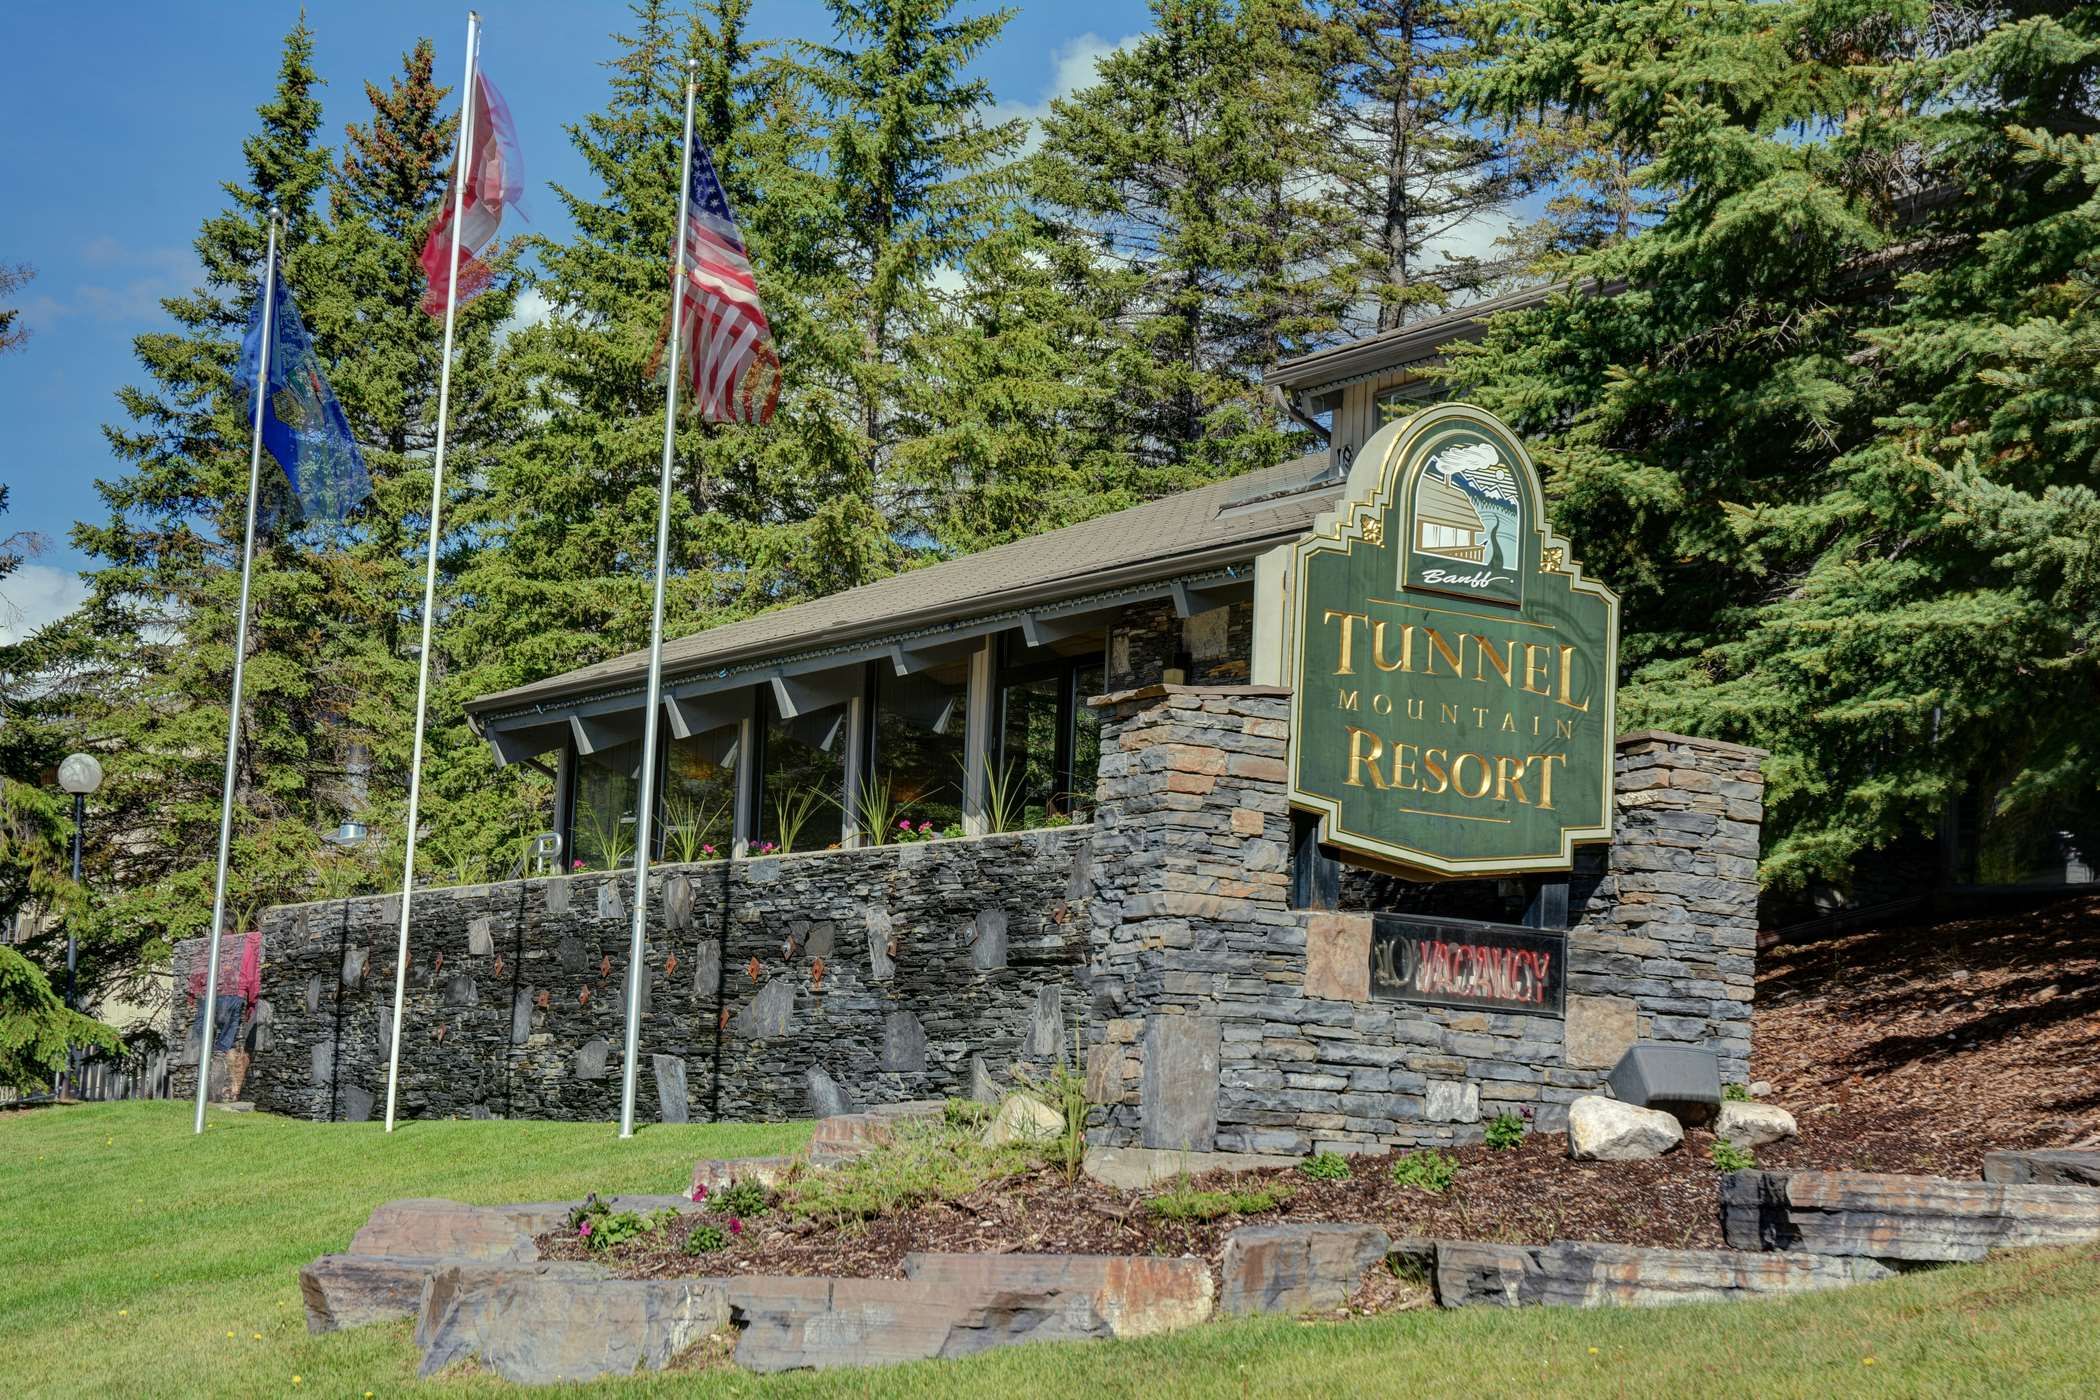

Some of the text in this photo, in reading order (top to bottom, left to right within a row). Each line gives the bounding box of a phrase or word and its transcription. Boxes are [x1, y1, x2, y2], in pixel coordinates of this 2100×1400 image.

[1421, 568, 1511, 588] Banff
[1323, 608, 1590, 713] TUNNEL
[1337, 687, 1574, 741] MOUNTAIN
[1343, 724, 1567, 811] RESORT
[1419, 939, 1550, 1004] VACANCY
